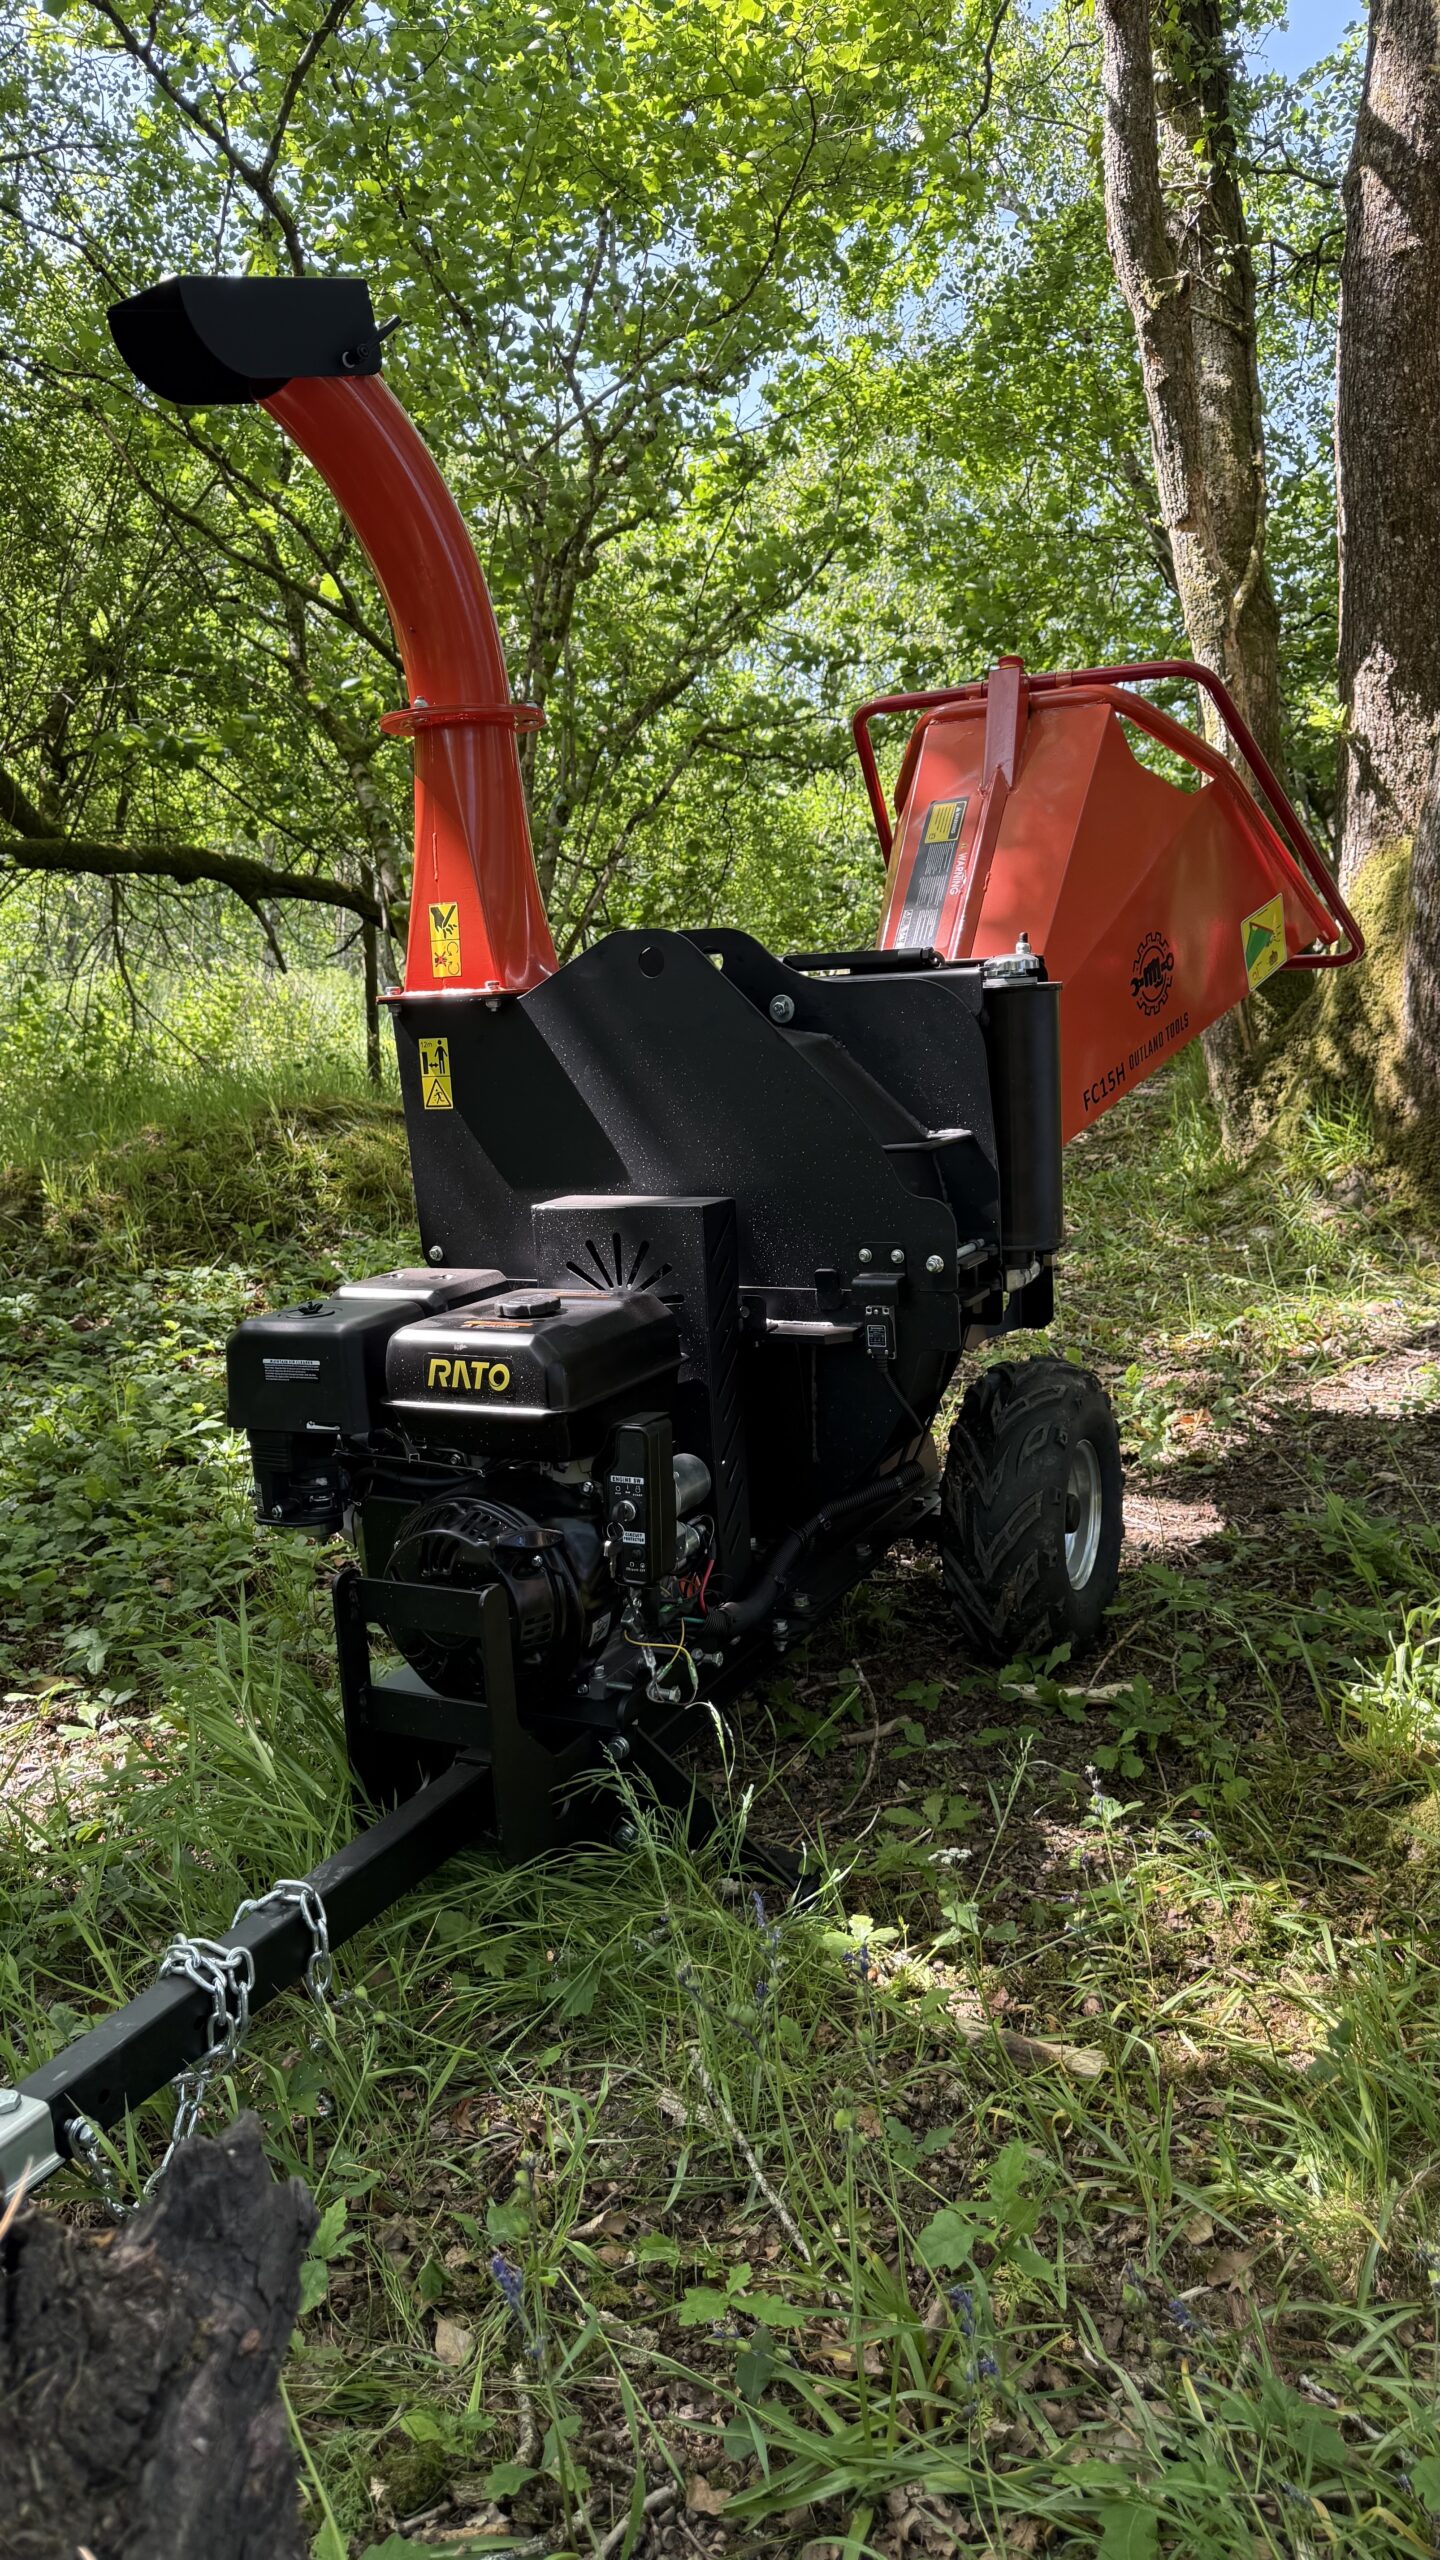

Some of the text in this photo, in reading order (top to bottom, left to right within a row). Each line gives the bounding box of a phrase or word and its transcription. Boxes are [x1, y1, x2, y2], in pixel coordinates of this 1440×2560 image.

[949, 852, 968, 896] WARNING
[1083, 1012, 1189, 1112] FC15H OUTLAND TOOLS
[427, 1358, 511, 1392] RATO
